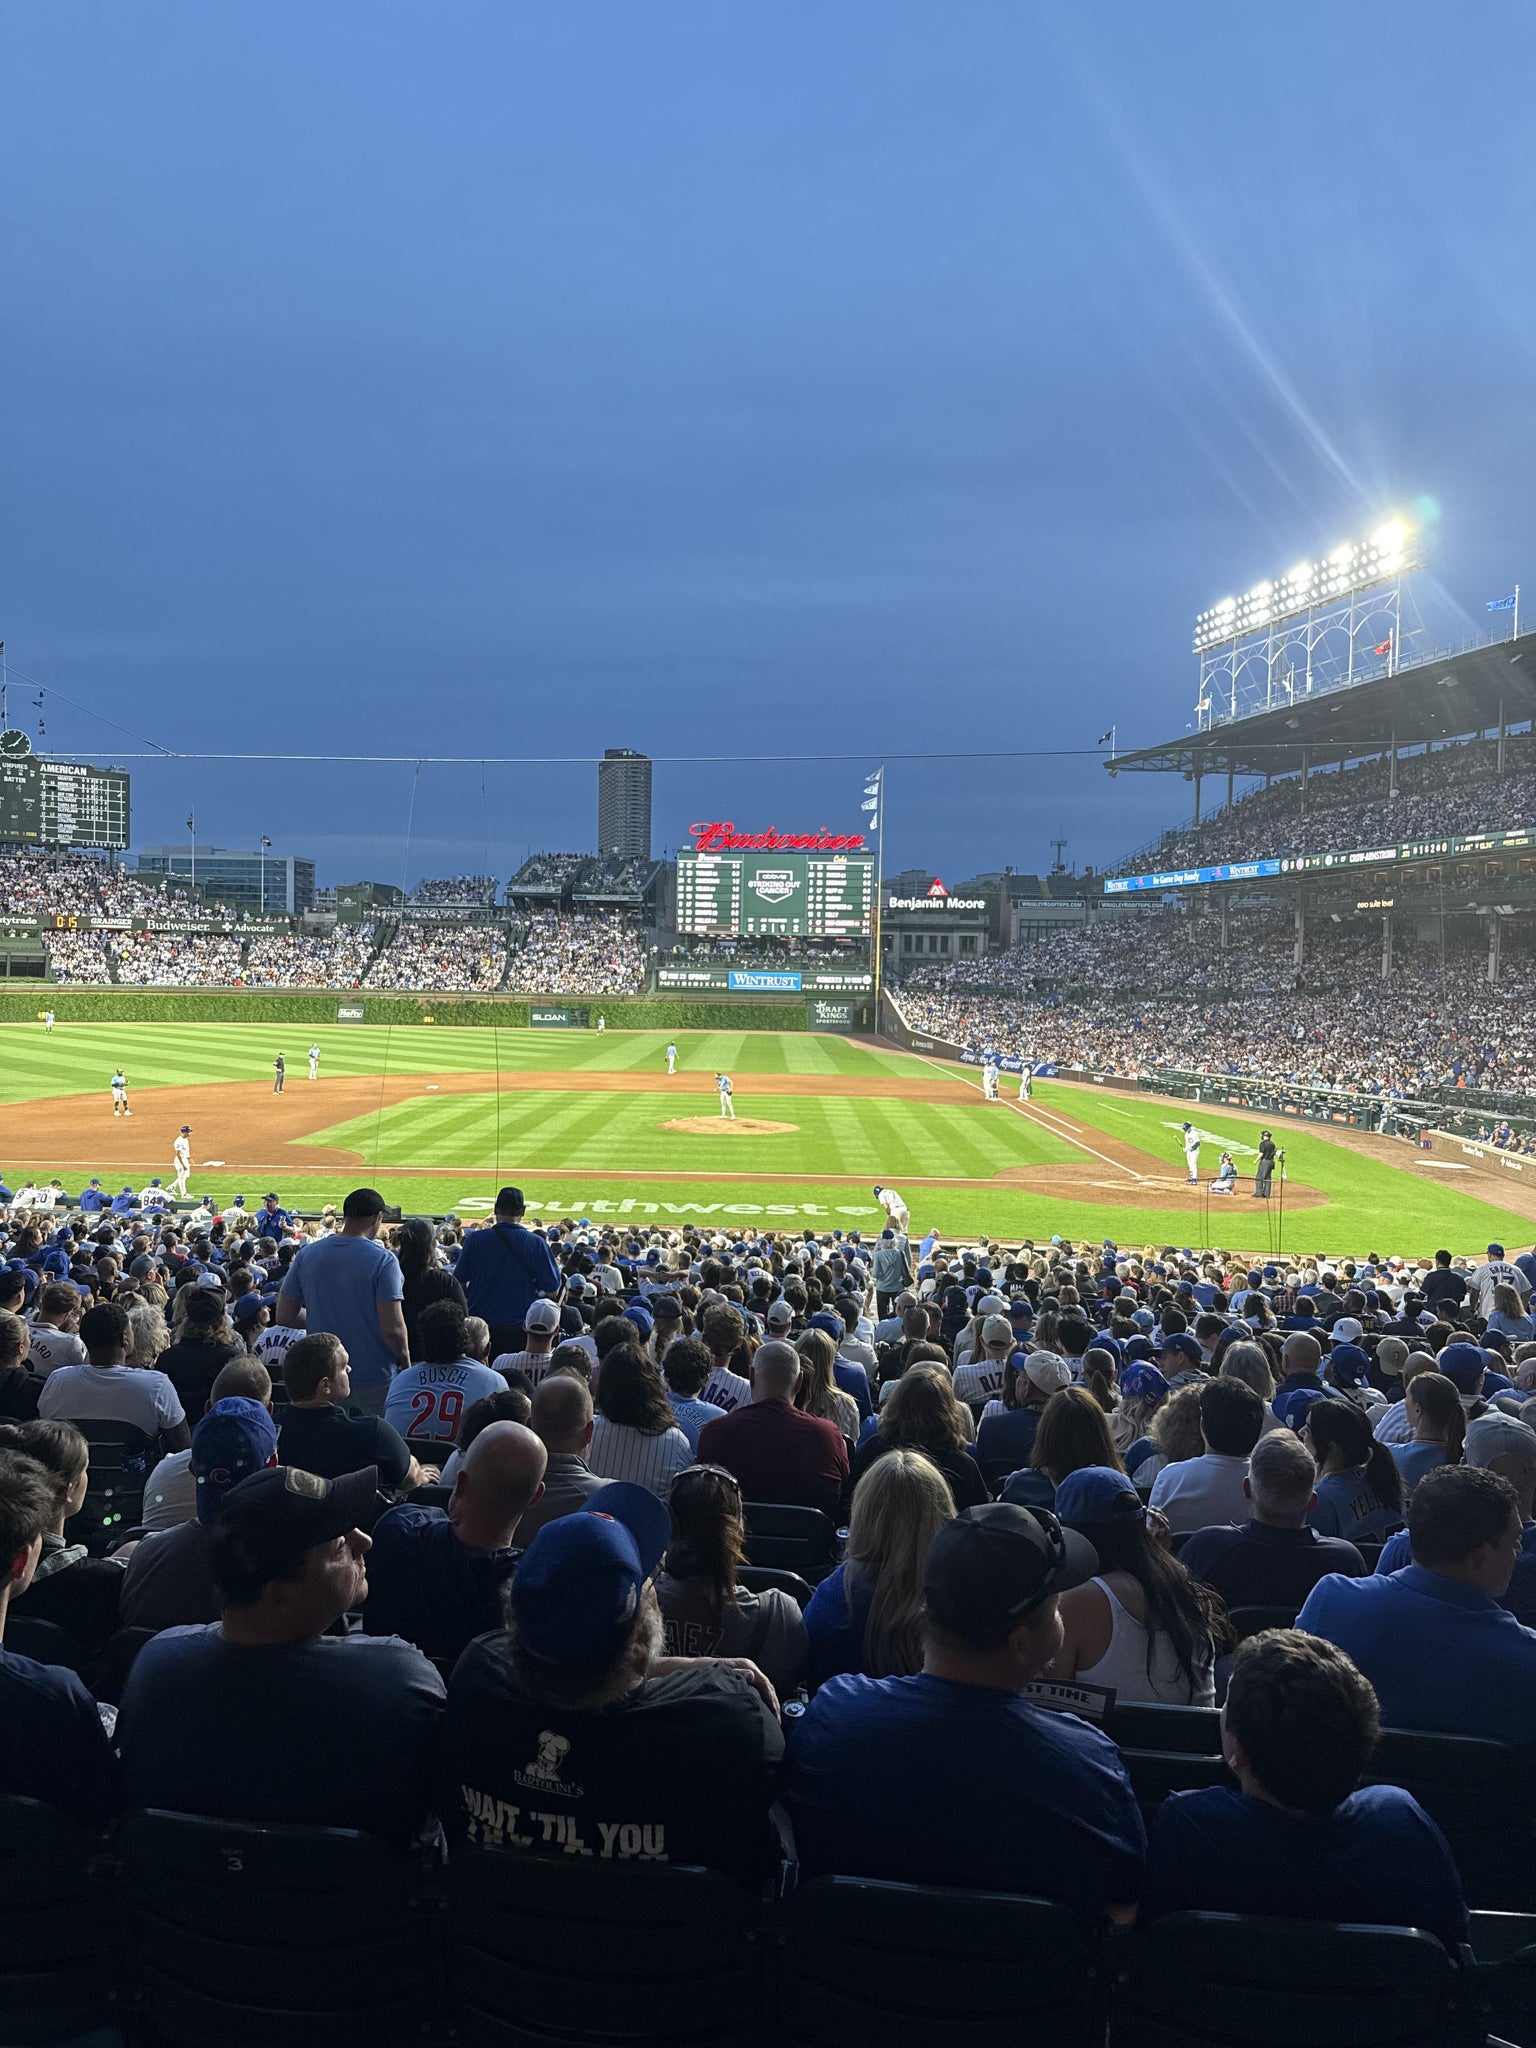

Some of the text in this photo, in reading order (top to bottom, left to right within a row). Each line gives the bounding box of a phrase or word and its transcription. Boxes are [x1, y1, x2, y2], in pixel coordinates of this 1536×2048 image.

[40, 763, 87, 776] AMERICAN
[4, 776, 26, 784] BATTER
[26, 803, 33, 811] 2
[689, 821, 866, 852] Budweiser
[1160, 875, 1174, 885] Game
[1174, 873, 1183, 884] Day
[1184, 871, 1200, 883] Ready
[889, 896, 985, 910] Benjamin Moore
[90, 917, 133, 925] GRAINGER
[234, 923, 275, 933] Advocate
[733, 973, 798, 987] WINTRUST
[451, 1196, 829, 1216] Suthwest
[1489, 1265, 1513, 1275] GRACE
[418, 1366, 469, 1386] BUSCH
[407, 1389, 465, 1442] 29
[665, 1619, 726, 1657] AEZ
[1048, 1685, 1091, 1704] TIME
[513, 1769, 585, 1795] BARTOLINI'S
[461, 1783, 520, 1834] WAIT
[597, 1822, 666, 1857] YOU
[228, 1857, 243, 1871] 3
